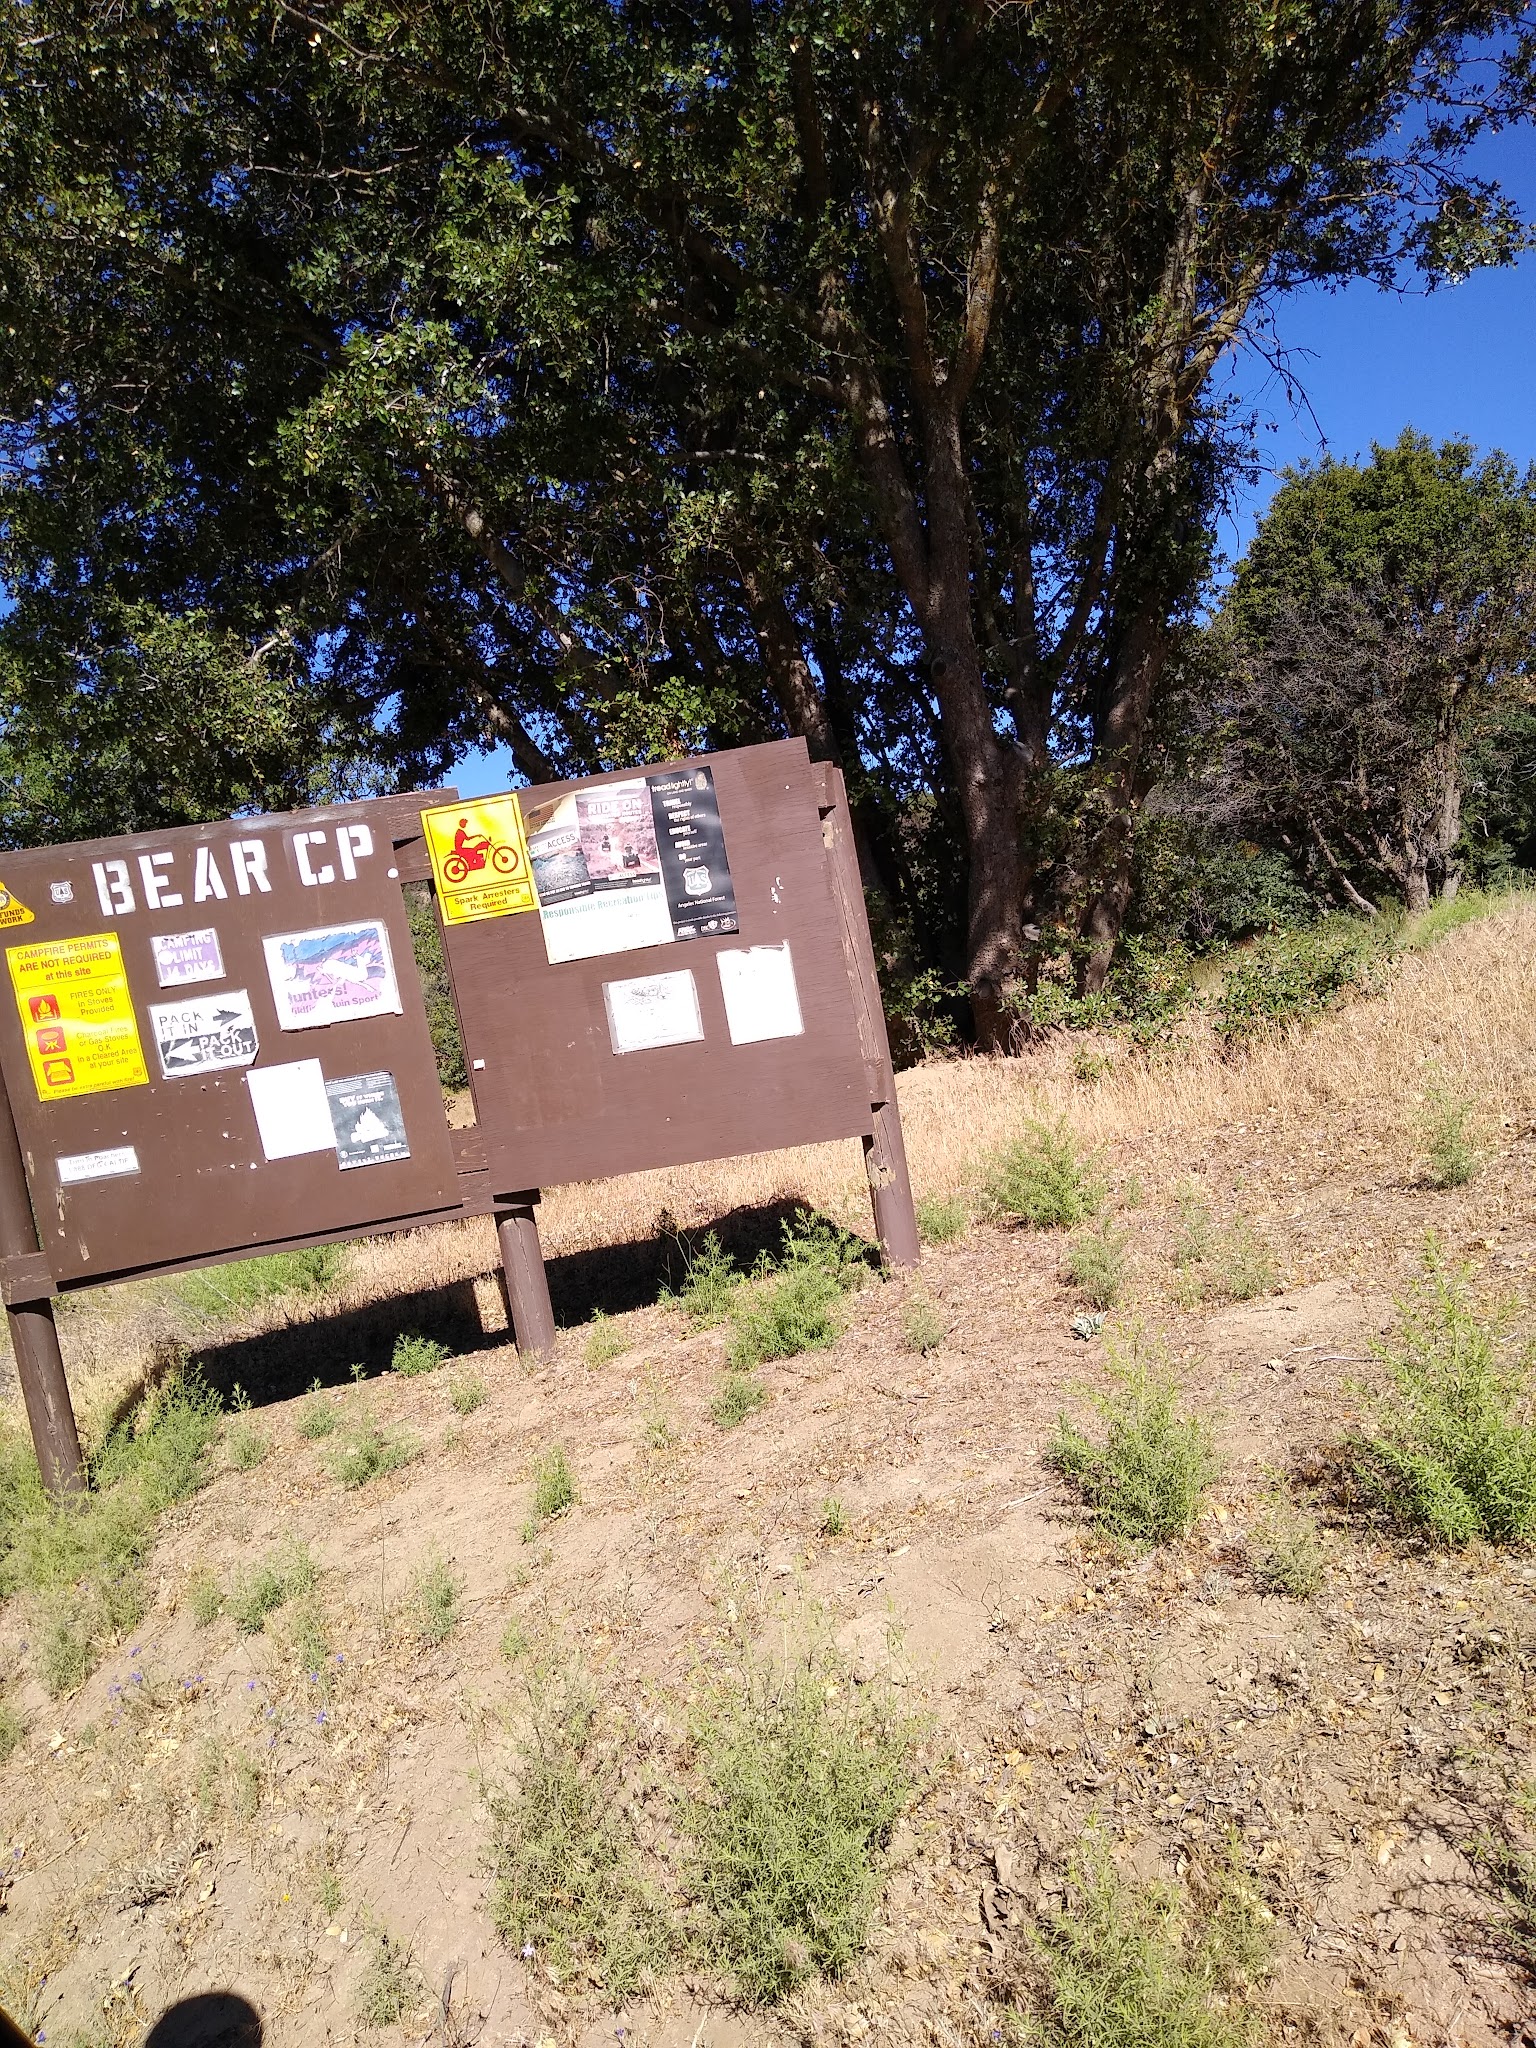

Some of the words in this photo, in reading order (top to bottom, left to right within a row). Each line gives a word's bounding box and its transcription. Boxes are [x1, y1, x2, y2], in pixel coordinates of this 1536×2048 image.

[587, 801, 619, 815] RIDE
[621, 798, 643, 811] ON
[547, 833, 575, 849] ACCESS
[92, 839, 272, 917] BEAR
[293, 824, 399, 887] CP.
[454, 895, 479, 905] Spark
[482, 887, 520, 900] Arresters
[694, 898, 712, 906] National
[470, 897, 508, 911] Required
[542, 903, 596, 920] Responsible
[597, 895, 644, 911] Recreation
[0, 908, 25, 918] FUNDS
[0, 915, 23, 925] WORK
[17, 946, 65, 960] CAMPFIRE
[67, 939, 108, 952] PERMITS
[173, 946, 203, 964] LIMIT
[19, 962, 39, 973] ARE
[41, 958, 60, 969] NOT
[63, 951, 112, 966] REQUIRED
[45, 972, 54, 981] at
[56, 970, 72, 979] this
[75, 967, 91, 976] site
[70, 989, 94, 1000] FIRES
[95, 986, 117, 996] ONLY
[87, 997, 113, 1006] Stoves
[81, 1004, 115, 1015] Provided
[159, 1011, 203, 1026] PACK
[76, 1029, 109, 1039] Charcoal
[161, 1026, 173, 1038] IT
[183, 1022, 198, 1034] IN
[88, 1037, 103, 1045] Gas
[104, 1034, 129, 1043] Stoves
[199, 1029, 243, 1049] PACK
[92, 1049, 119, 1061] Cleared
[121, 1047, 138, 1055] Area
[201, 1047, 216, 1060] IT
[221, 1040, 253, 1057] OUT
[98, 1060, 114, 1069] your
[116, 1057, 129, 1065] site
